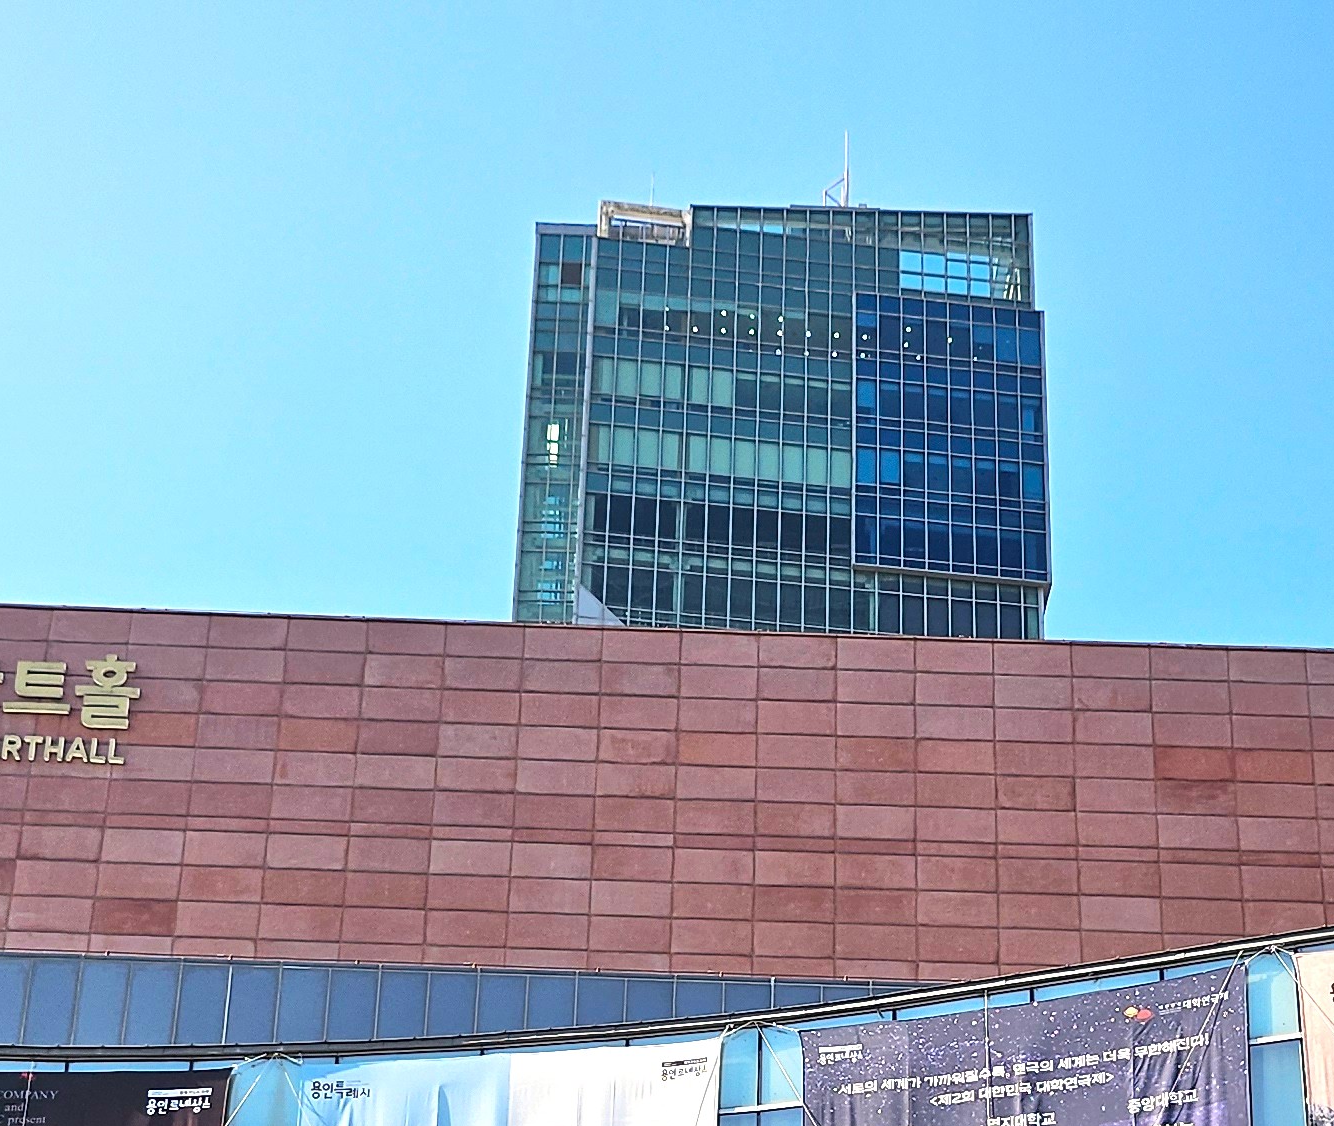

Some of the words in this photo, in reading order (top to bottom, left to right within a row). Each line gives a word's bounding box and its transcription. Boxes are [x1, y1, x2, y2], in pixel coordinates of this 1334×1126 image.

[838, 1078, 877, 1095] 서로의
[881, 1076, 921, 1090] 세계가
[1058, 1052, 1099, 1069] 세계는
[311, 1081, 370, 1099] 용인특례시
[979, 1082, 1032, 1098] 대한민국
[5, 1103, 24, 1112] and
[1127, 1089, 1198, 1114] 중앙대학교
[7, 1115, 46, 1125] present
